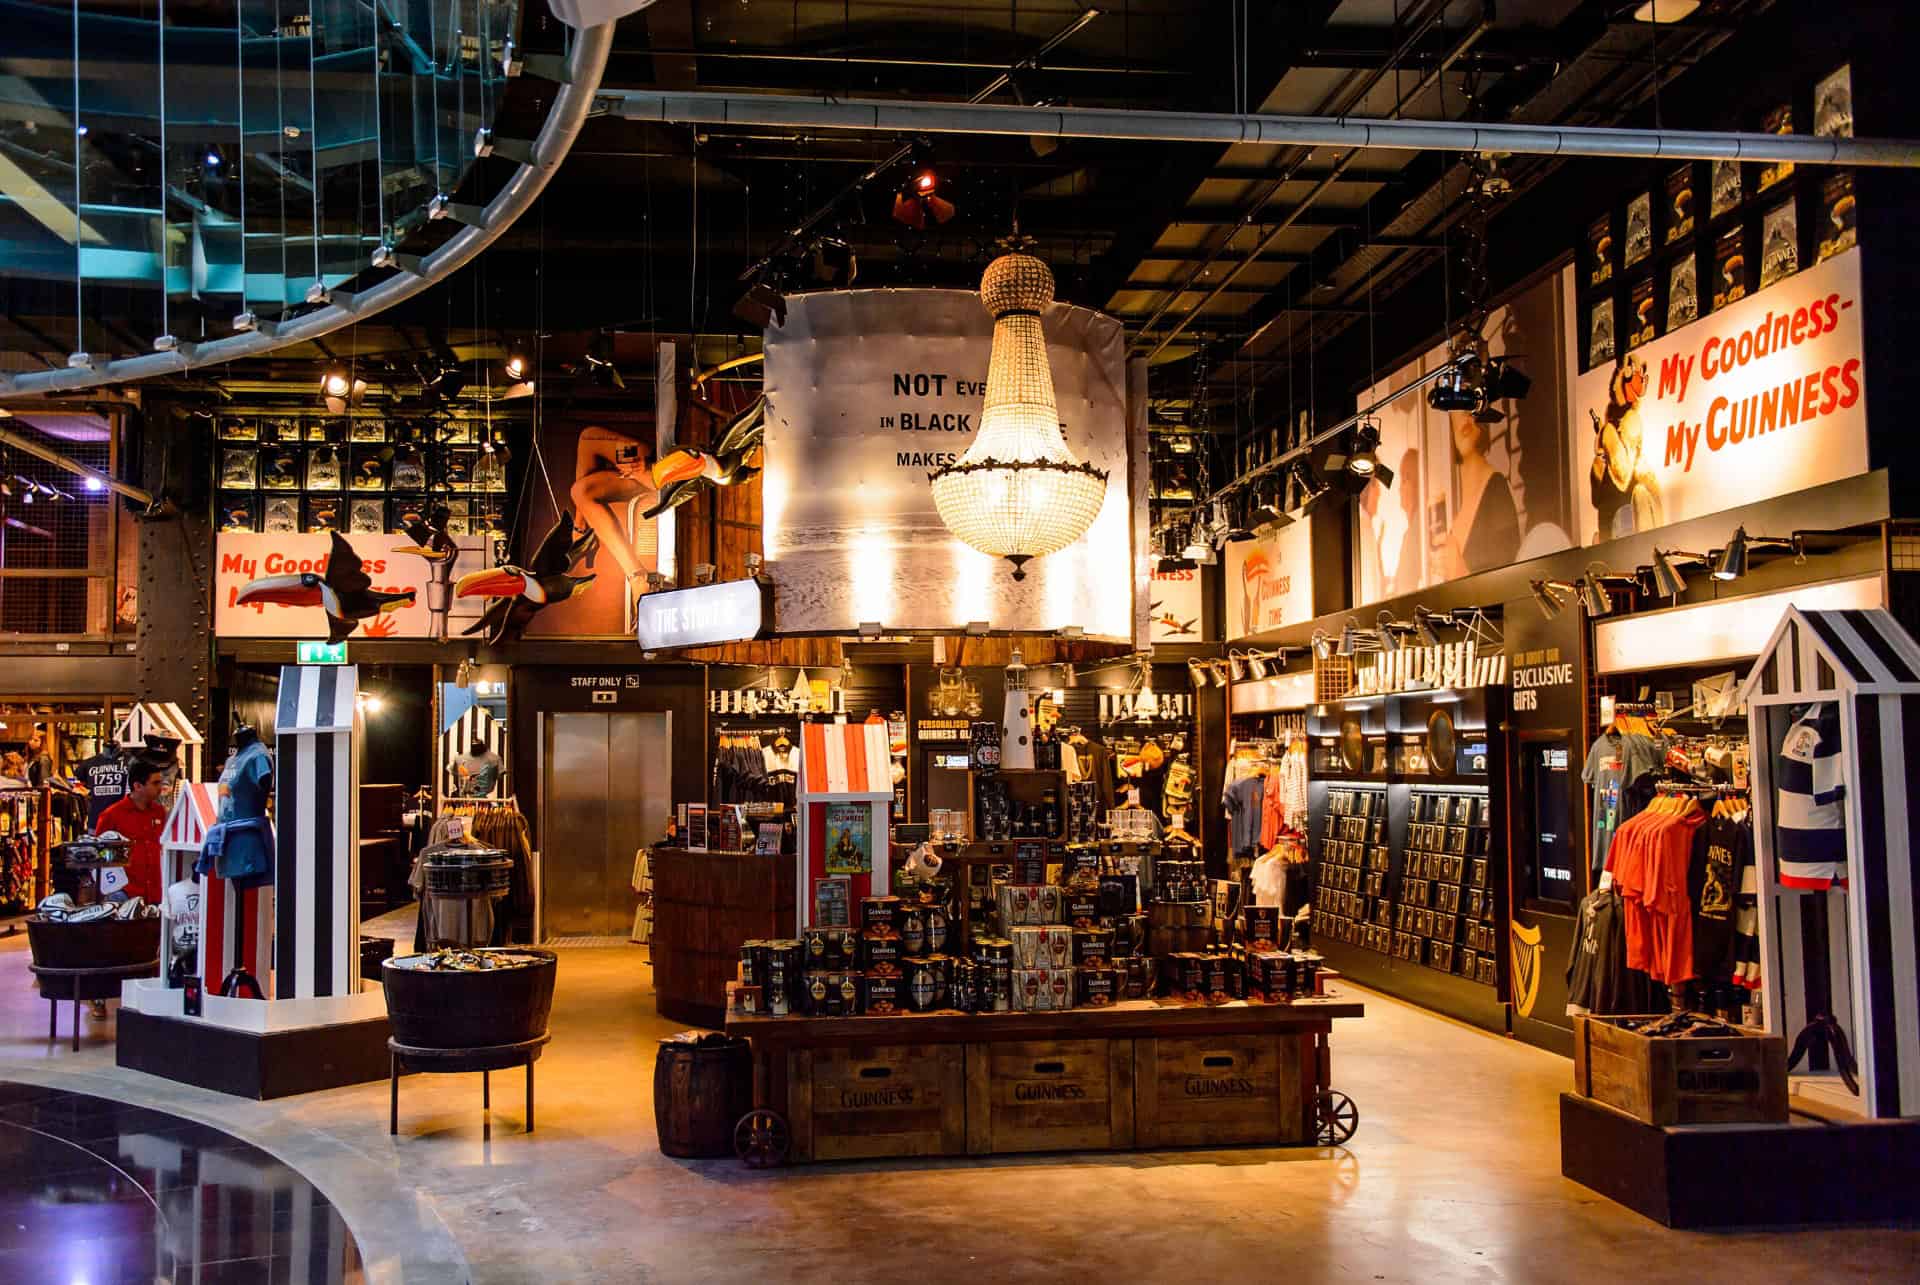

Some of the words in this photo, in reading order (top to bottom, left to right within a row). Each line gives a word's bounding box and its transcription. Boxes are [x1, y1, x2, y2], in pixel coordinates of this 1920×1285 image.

[1657, 351, 1695, 403] My
[1700, 293, 1853, 381] Goodness-
[893, 374, 947, 397] NOT
[880, 417, 894, 428] IN
[900, 413, 971, 432] BLACK
[1664, 420, 1701, 473] My
[1706, 358, 1860, 452] GUINNESS
[896, 452, 956, 467] MAKES
[221, 553, 257, 580] My
[265, 552, 387, 574] Goodss
[655, 607, 680, 632] THE
[571, 677, 598, 687] STAFF
[599, 677, 621, 687] ONLY
[1513, 664, 1574, 689] EXCLUSIVE
[1513, 690, 1537, 712] GIFTS
[94, 773, 122, 785] 1759
[105, 871, 117, 884] 5
[840, 1087, 914, 1109] GUINNESS
[1015, 1083, 1086, 1100] GUINNESS
[1184, 1078, 1254, 1097] GUINNESS
